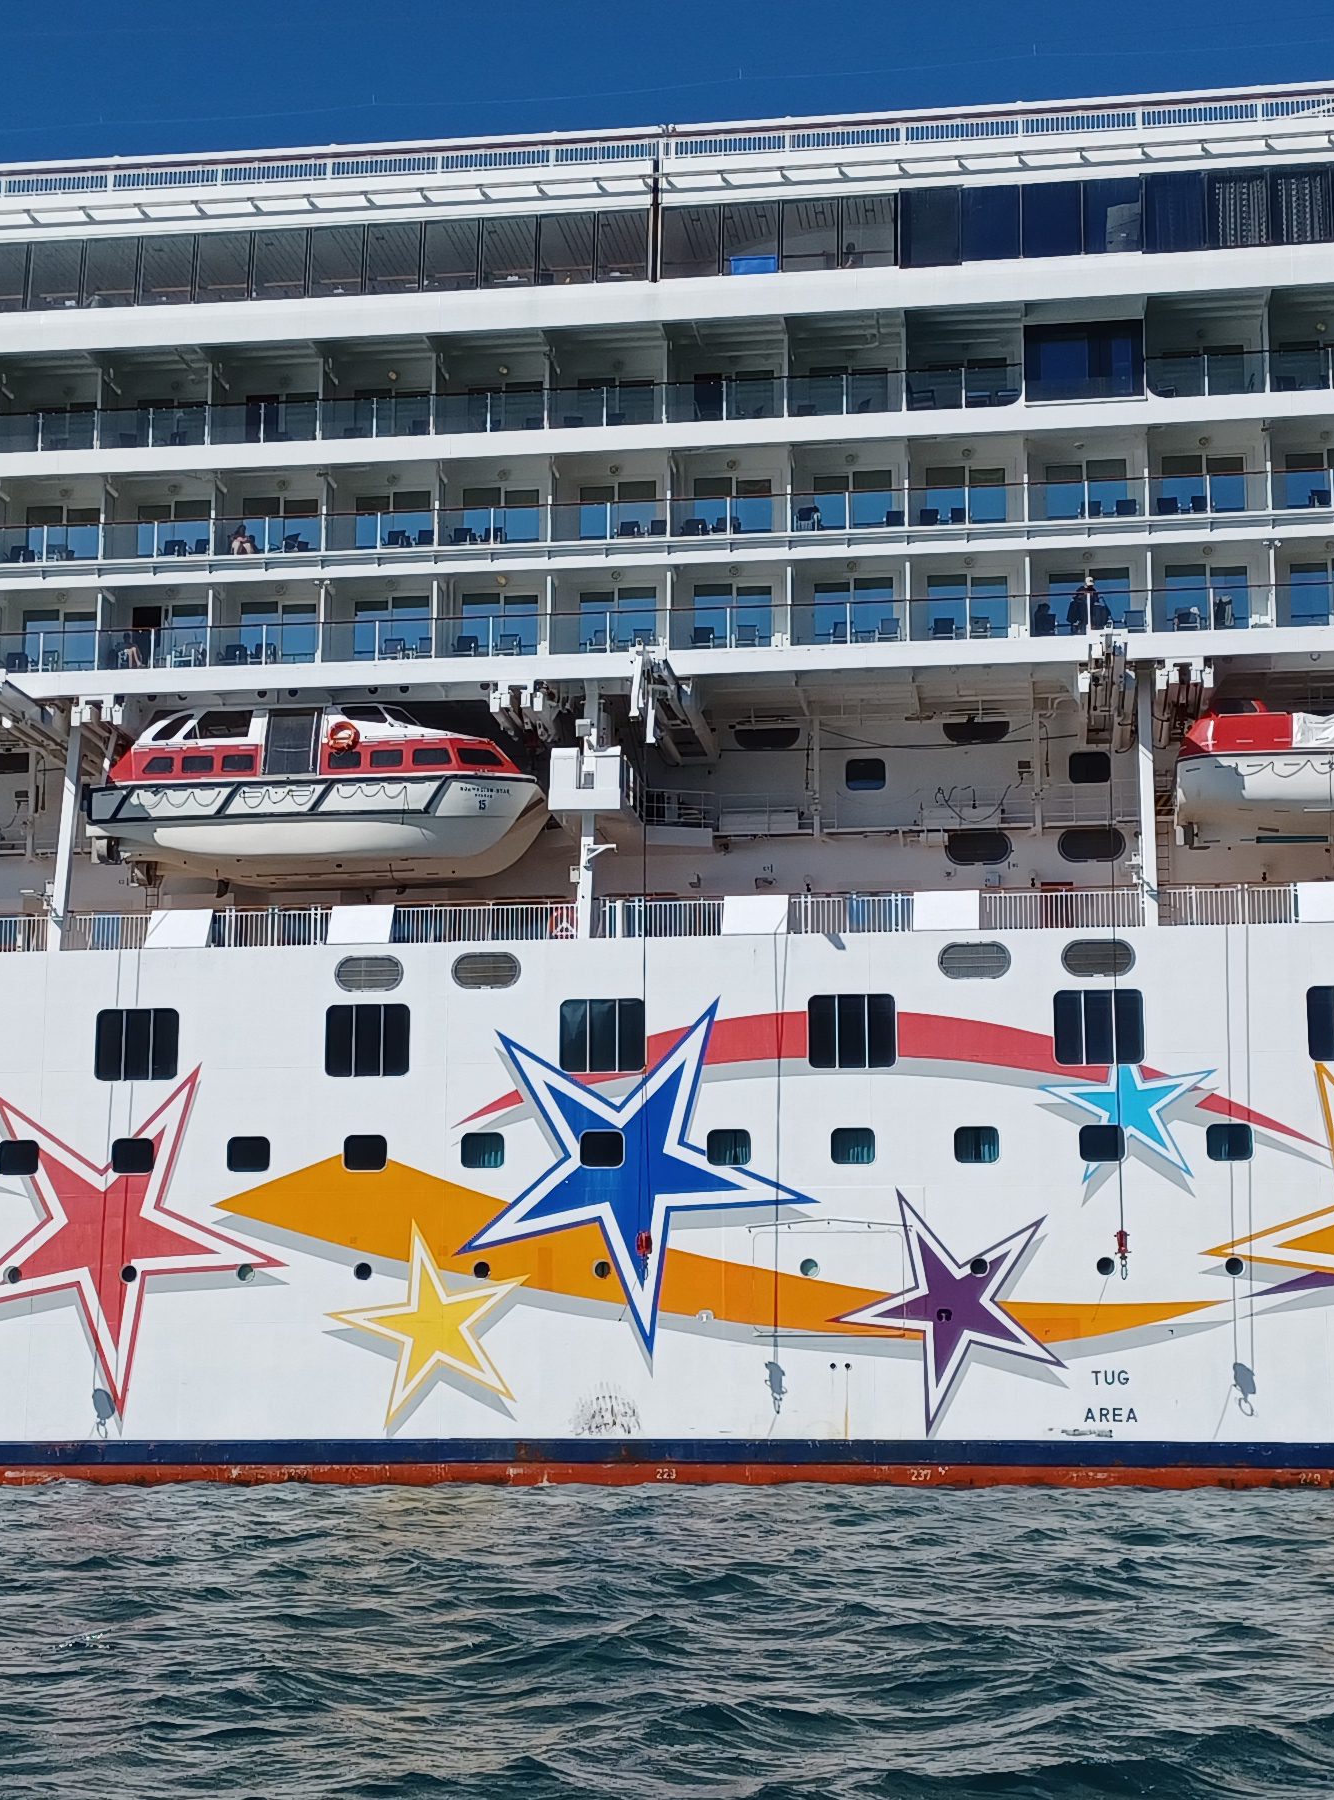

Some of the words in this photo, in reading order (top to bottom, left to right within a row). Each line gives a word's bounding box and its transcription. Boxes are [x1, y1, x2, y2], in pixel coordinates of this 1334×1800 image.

[478, 799, 486, 810] 15
[1091, 1370, 1130, 1386] TUG
[1083, 1407, 1138, 1423] AREA
